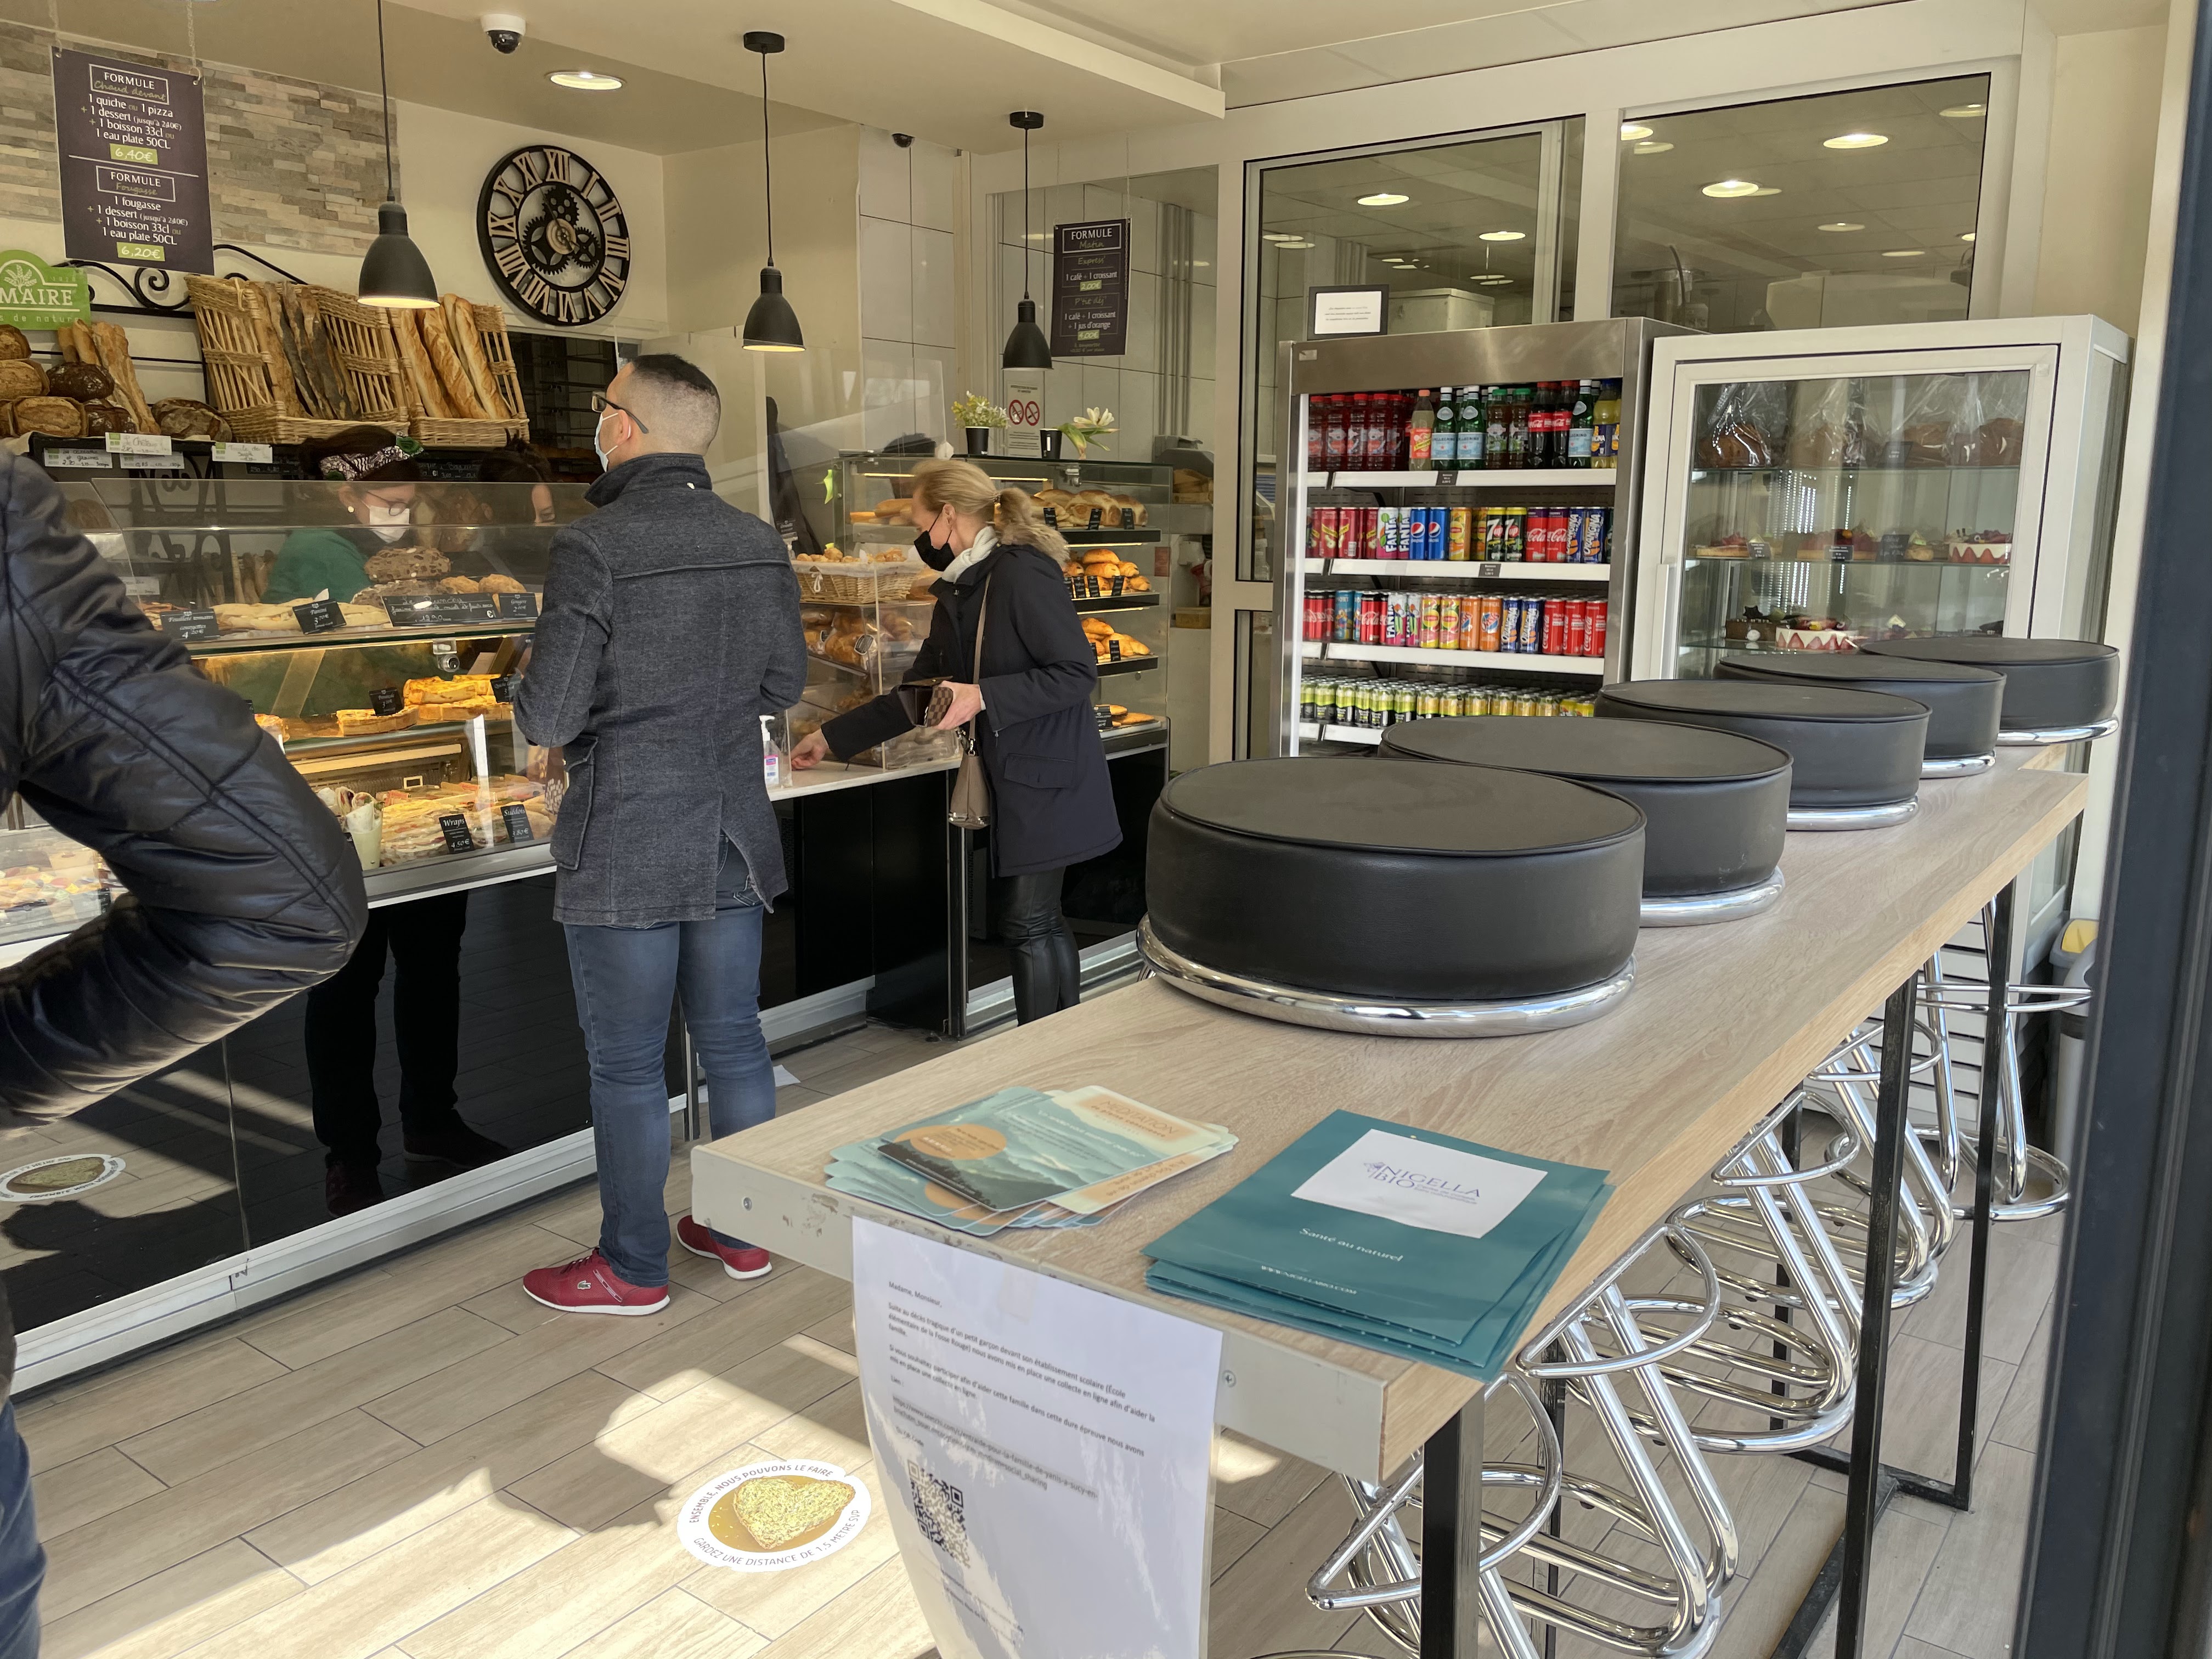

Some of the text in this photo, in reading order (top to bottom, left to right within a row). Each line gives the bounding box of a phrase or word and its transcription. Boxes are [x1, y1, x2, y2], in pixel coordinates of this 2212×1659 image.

[94, 81, 166, 101] Chaud devant
[104, 72, 155, 90] FORMULE
[89, 94, 92, 103] 1
[96, 97, 127, 109] quiche
[142, 103, 145, 112] 1
[148, 105, 173, 118] pizza
[91, 105, 94, 115] 1
[99, 108, 131, 121] dessert
[100, 118, 103, 127] 1
[108, 119, 142, 134] boisson
[145, 126, 163, 137] 33cl
[96, 128, 171, 149] 1 eau plate 50CL
[115, 148, 153, 162] 6,40€
[512, 151, 543, 191] XI
[543, 148, 571, 185] XII
[111, 172, 161, 187] FORMULE
[116, 182, 158, 195] Fougasse
[493, 174, 524, 209] X
[98, 205, 101, 214] 1
[105, 206, 137, 219] dessert
[115, 196, 161, 211] 1 fougasse
[596, 198, 622, 223] II
[106, 217, 110, 226] 1
[114, 217, 149, 231] boisson
[151, 223, 170, 234] 33cl
[488, 210, 517, 240] IX
[1071, 228, 1113, 240] FORMULE
[103, 227, 177, 245] 1 eau plate 50CL
[1079, 240, 1105, 249] Matin
[121, 246, 161, 259] 6,20€
[605, 234, 629, 261] III
[601, 267, 625, 302] IV
[1070, 273, 1082, 281] café
[1093, 271, 1118, 279] croissant
[0, 287, 73, 306] MAIRE
[558, 291, 580, 323] VI
[584, 287, 606, 320] V
[14, 313, 26, 322] de
[1069, 312, 1081, 320] café
[1092, 311, 1116, 319] croissant
[1077, 322, 1086, 330] jus
[1087, 321, 1110, 330] d'orange
[1385, 517, 1397, 553] FANTA
[1399, 517, 1410, 552] FANTA
[1386, 605, 1395, 639] FANTA
[443, 817, 465, 828] Wraps
[1374, 1172, 1415, 1188] BIO
[1381, 1166, 1480, 1198] NIGELLA
[1299, 1228, 1404, 1262] Santé au naturel
[889, 1281, 942, 1308] Madame, Monsieur,
[889, 1302, 901, 1313] Suite
[910, 1310, 926, 1323] décès
[927, 1318, 950, 1333] tragique
[951, 1327, 963, 1338] d'un
[964, 1332, 978, 1344] petit
[979, 1339, 999, 1351] garçon
[1000, 1345, 1021, 1360] devant
[1022, 1354, 1033, 1364] son
[1035, 1358, 1078, 1380] établissement
[1079, 1374, 1104, 1391] scolaire
[1106, 1384, 1126, 1399] (École
[889, 1313, 919, 1331] élémentaire
[921, 1326, 928, 1334] de
[929, 1329, 934, 1337] la
[935, 1331, 950, 1344] Fosse
[972, 1347, 986, 1358] nous
[988, 1353, 1005, 1365] avons
[1006, 1359, 1016, 1370] mis
[1018, 1364, 1025, 1373] en
[1026, 1368, 1042, 1380] place
[1044, 1375, 1056, 1384] une
[1057, 1379, 1082, 1395] collecte
[1083, 1390, 1091, 1398] en
[1093, 1392, 1108, 1405] ligne
[1110, 1400, 1122, 1410] afin
[1124, 1403, 1148, 1420] d'aider
[1149, 1413, 1155, 1423] la
[961, 1374, 971, 1385] afin
[972, 1380, 992, 1394] d'aider
[993, 1389, 1008, 1401] cette
[1009, 1395, 1030, 1409] famille
[1031, 1404, 1046, 1417] dans
[1046, 1412, 1063, 1423] cette
[1064, 1418, 1079, 1431] dure
[1080, 1425, 1107, 1441] épreuve
[1107, 1436, 1124, 1448] nous
[1125, 1444, 1144, 1457] avons
[689, 1491, 719, 1523] ENSEMBLE,
[716, 1475, 742, 1491] NOUS
[742, 1464, 792, 1479] POUVONS
[807, 1465, 833, 1477] FAIRE
[693, 1537, 724, 1558] GARDEZ
[722, 1554, 743, 1565] UNE
[746, 1554, 797, 1566] DISTANCE
[799, 1549, 815, 1559] DE
[849, 1510, 860, 1523] SVP
